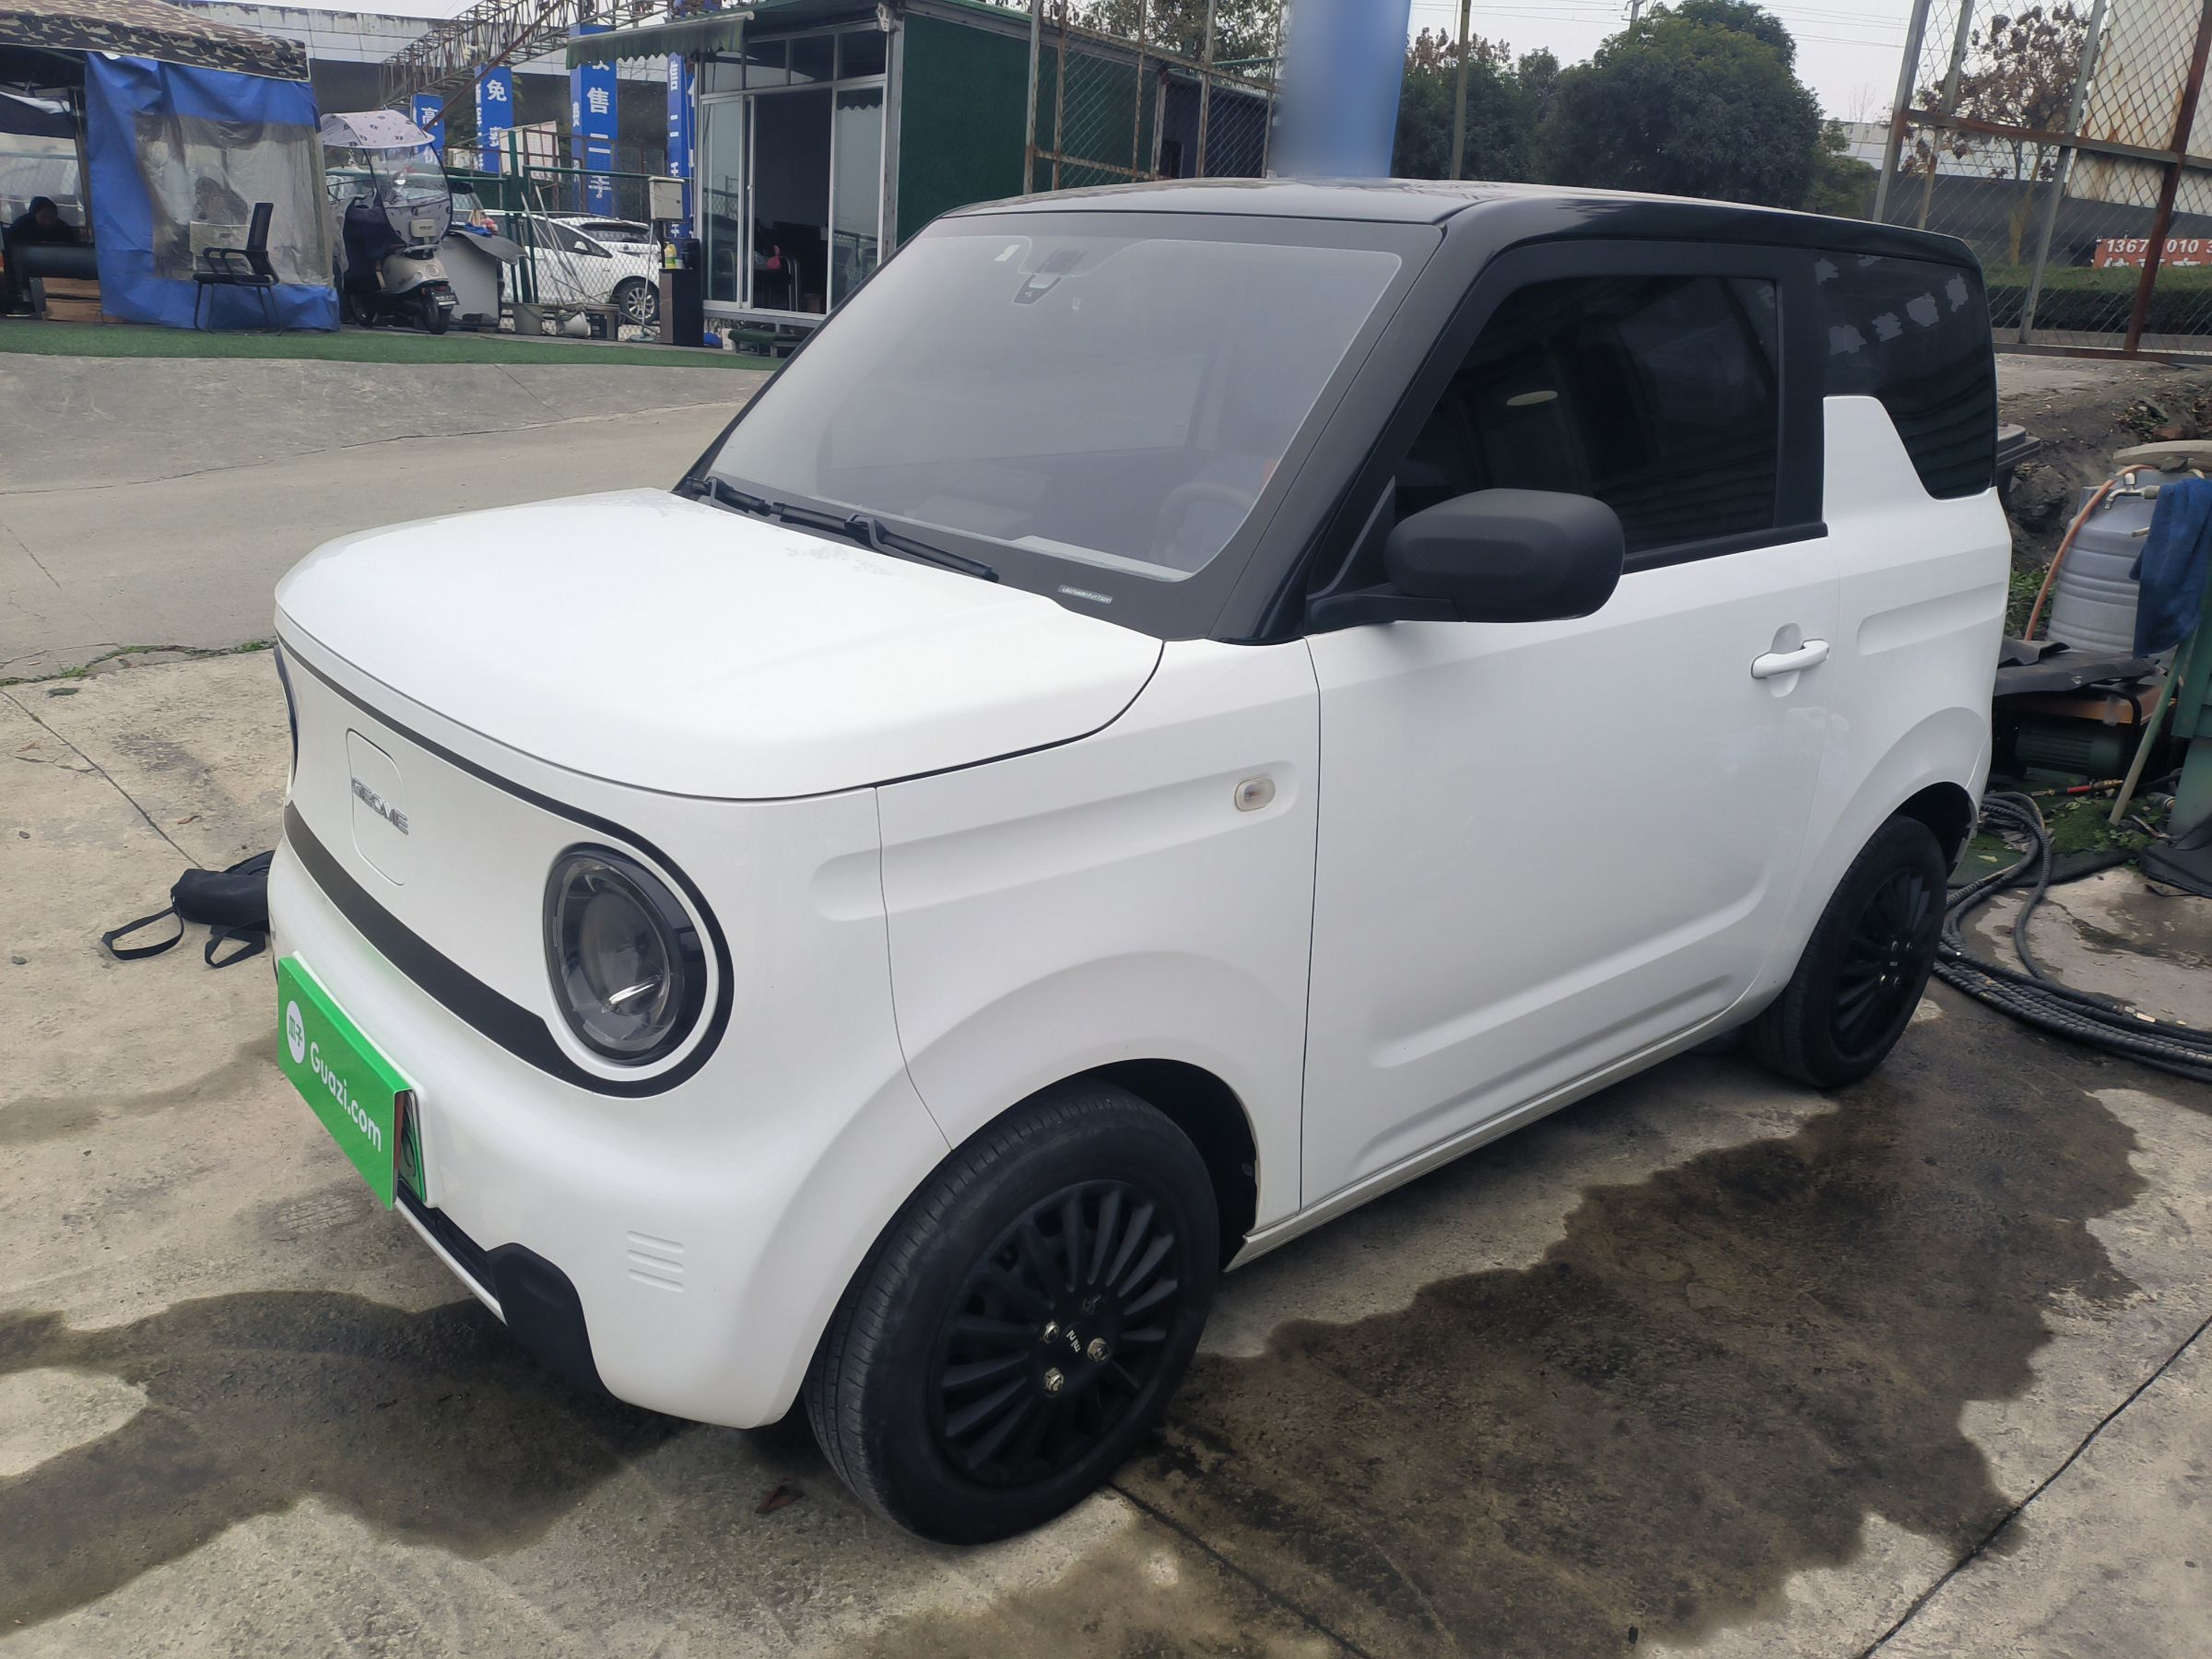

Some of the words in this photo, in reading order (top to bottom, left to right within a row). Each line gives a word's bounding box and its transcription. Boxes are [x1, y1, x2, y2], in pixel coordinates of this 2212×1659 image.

[2107, 239, 2152, 253] 1367
[2166, 239, 2199, 253] 010
[310, 1041, 381, 1152] Guazi.com
